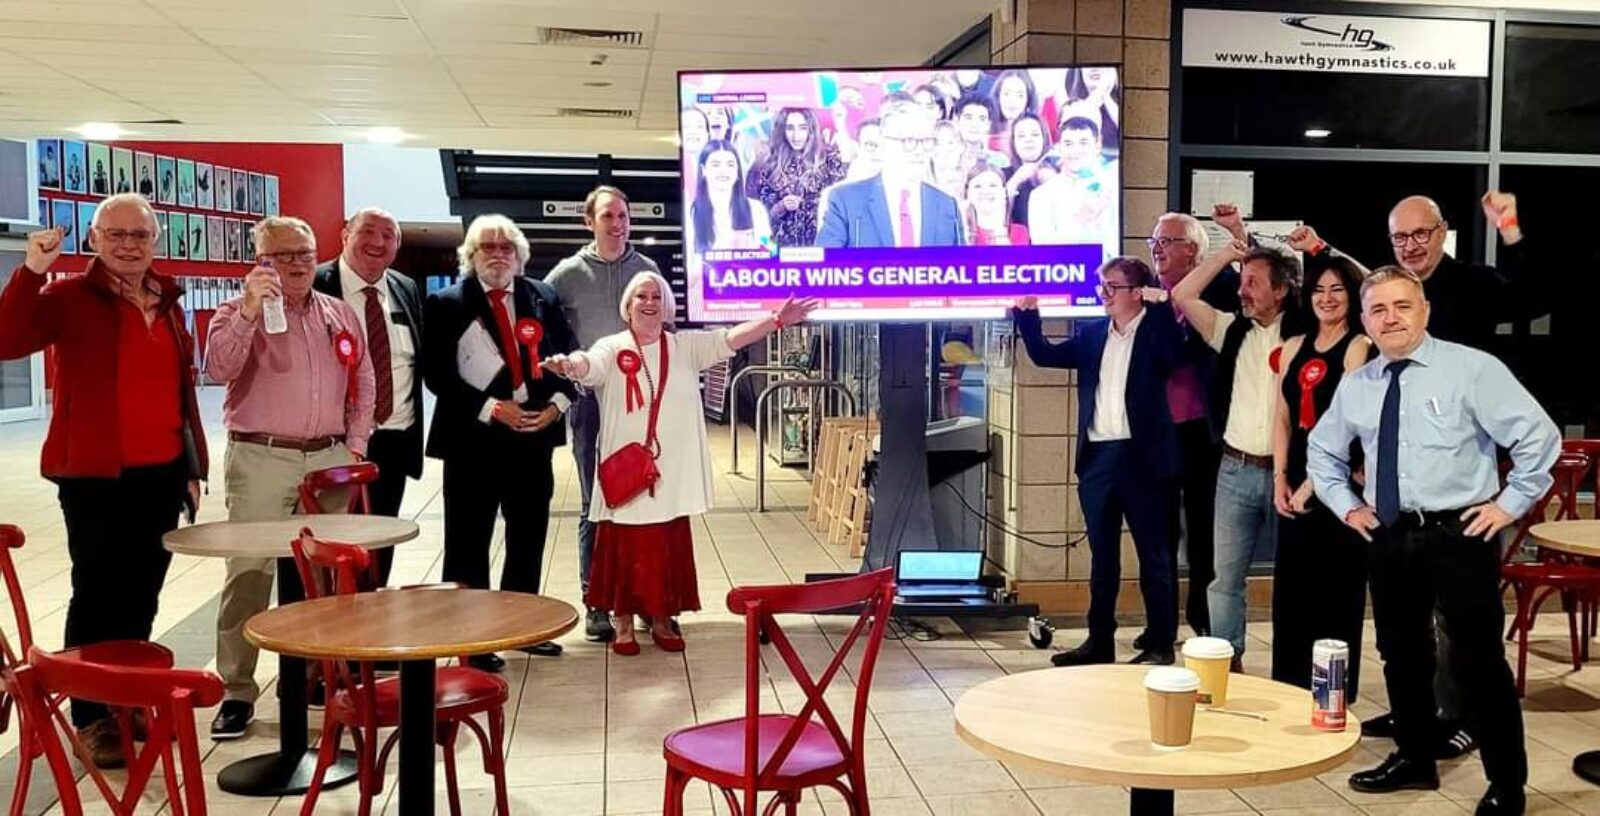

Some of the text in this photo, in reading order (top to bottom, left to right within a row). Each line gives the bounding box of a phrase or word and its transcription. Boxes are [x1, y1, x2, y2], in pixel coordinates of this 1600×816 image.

[1341, 23, 1375, 48] hg
[1214, 50, 1457, 71] www.hawthgymnastics.co.uk
[708, 264, 1086, 287] LABOUR WINS GENERAL ELECTION
